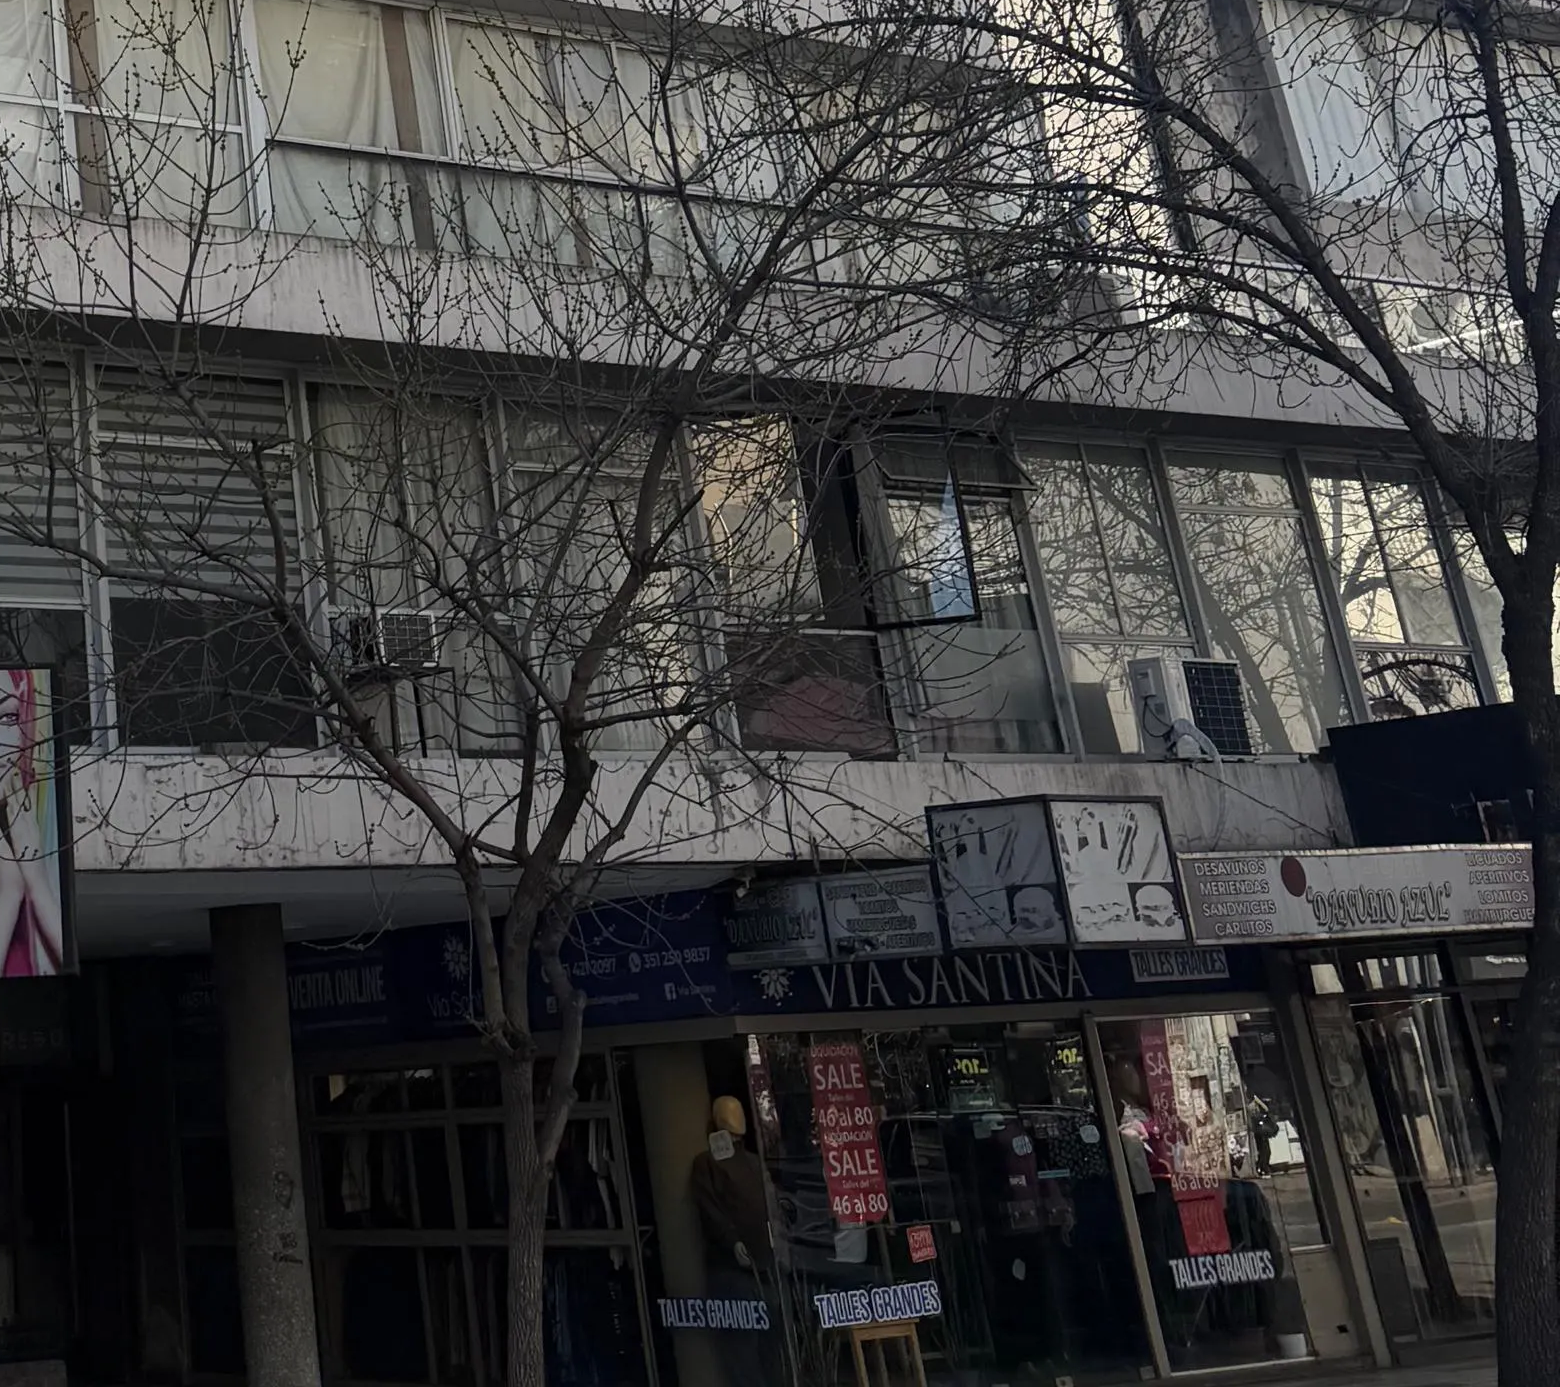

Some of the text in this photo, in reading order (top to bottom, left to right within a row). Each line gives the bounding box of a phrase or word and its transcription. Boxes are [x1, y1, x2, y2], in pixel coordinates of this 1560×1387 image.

[1193, 859, 1267, 876] DESAYUNOS
[1469, 869, 1530, 885] APERITIVOS
[1199, 879, 1270, 896] MERIENDAS
[1478, 889, 1530, 905] LOMITOS
[1201, 899, 1277, 917] SANDWICHS
[1464, 907, 1535, 925] HAMBURGUE
[1214, 919, 1274, 936] CARLITOS
[643, 952, 661, 969] 351
[1131, 949, 1226, 977] TALLES GRANDES
[288, 964, 387, 1010] VENTA ONLINE
[901, 949, 1094, 1005] SANTINA
[814, 1063, 864, 1091] SALE
[819, 1106, 874, 1128] 46 al 80
[828, 1148, 879, 1177] SALE
[833, 1192, 889, 1215] 46 al 80
[1169, 1248, 1276, 1291] TALLES GRANDES
[657, 1298, 771, 1330] TALLES GRANDES
[814, 1280, 941, 1328] TALLES GRANDES
